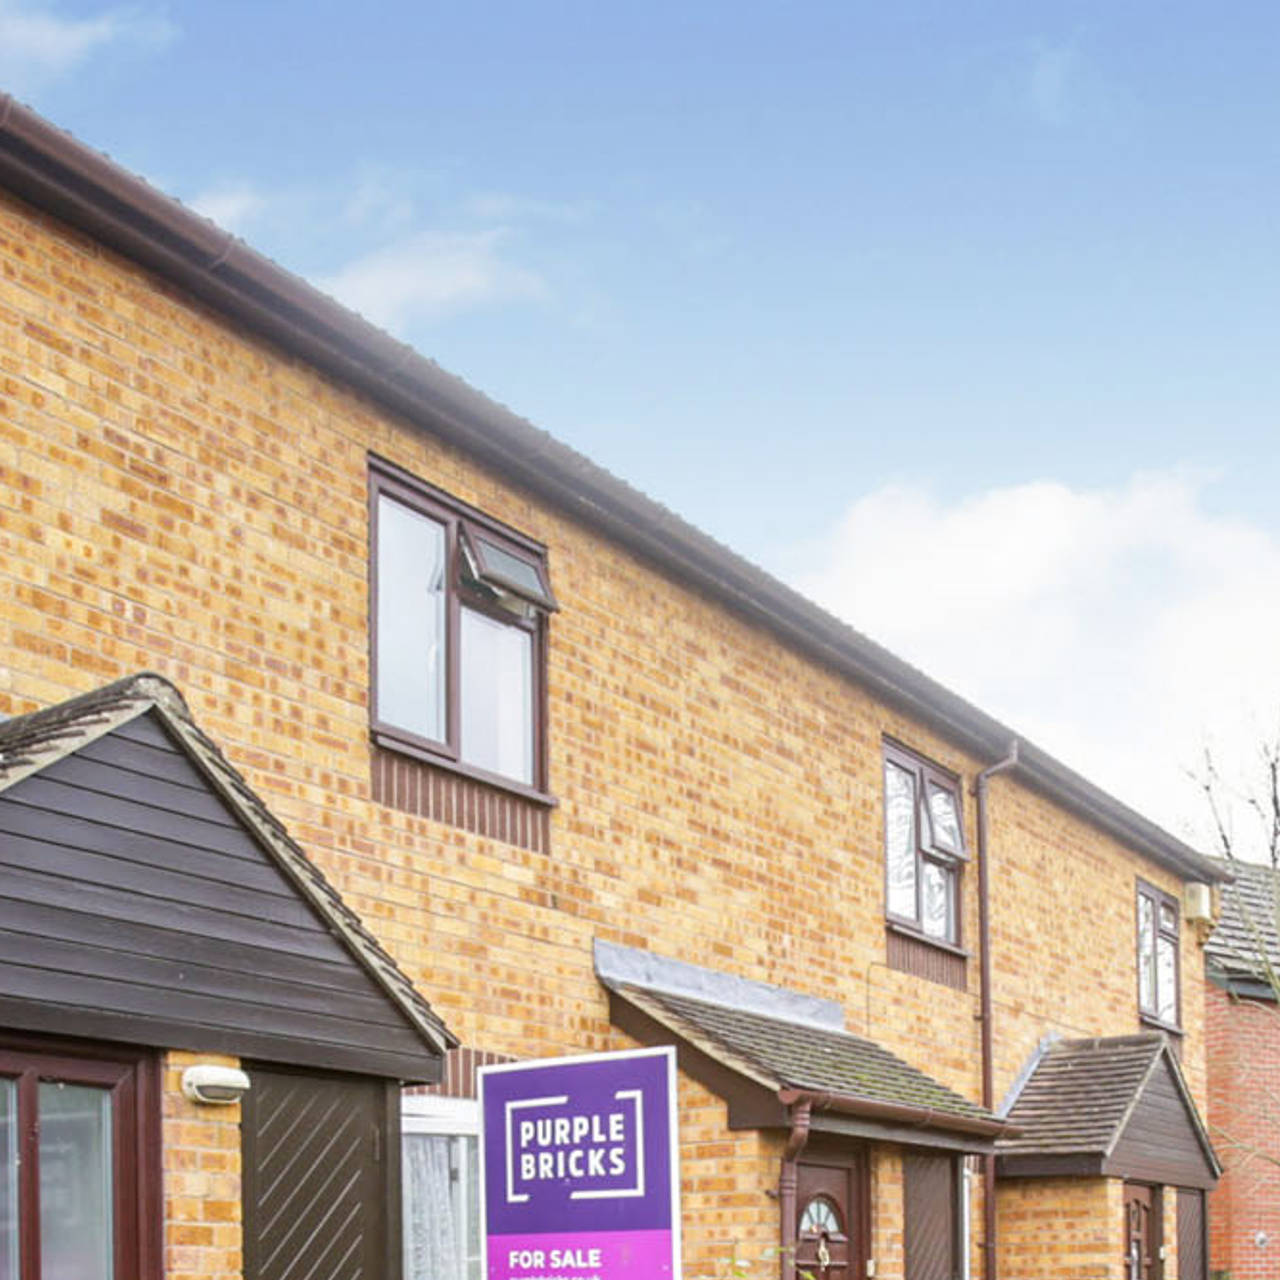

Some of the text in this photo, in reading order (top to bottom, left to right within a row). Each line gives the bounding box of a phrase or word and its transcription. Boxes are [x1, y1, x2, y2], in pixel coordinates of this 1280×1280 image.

[520, 1114, 624, 1148] PURPLE
[521, 1148, 625, 1180] BRICKS
[509, 1248, 602, 1269] FOR SALE
